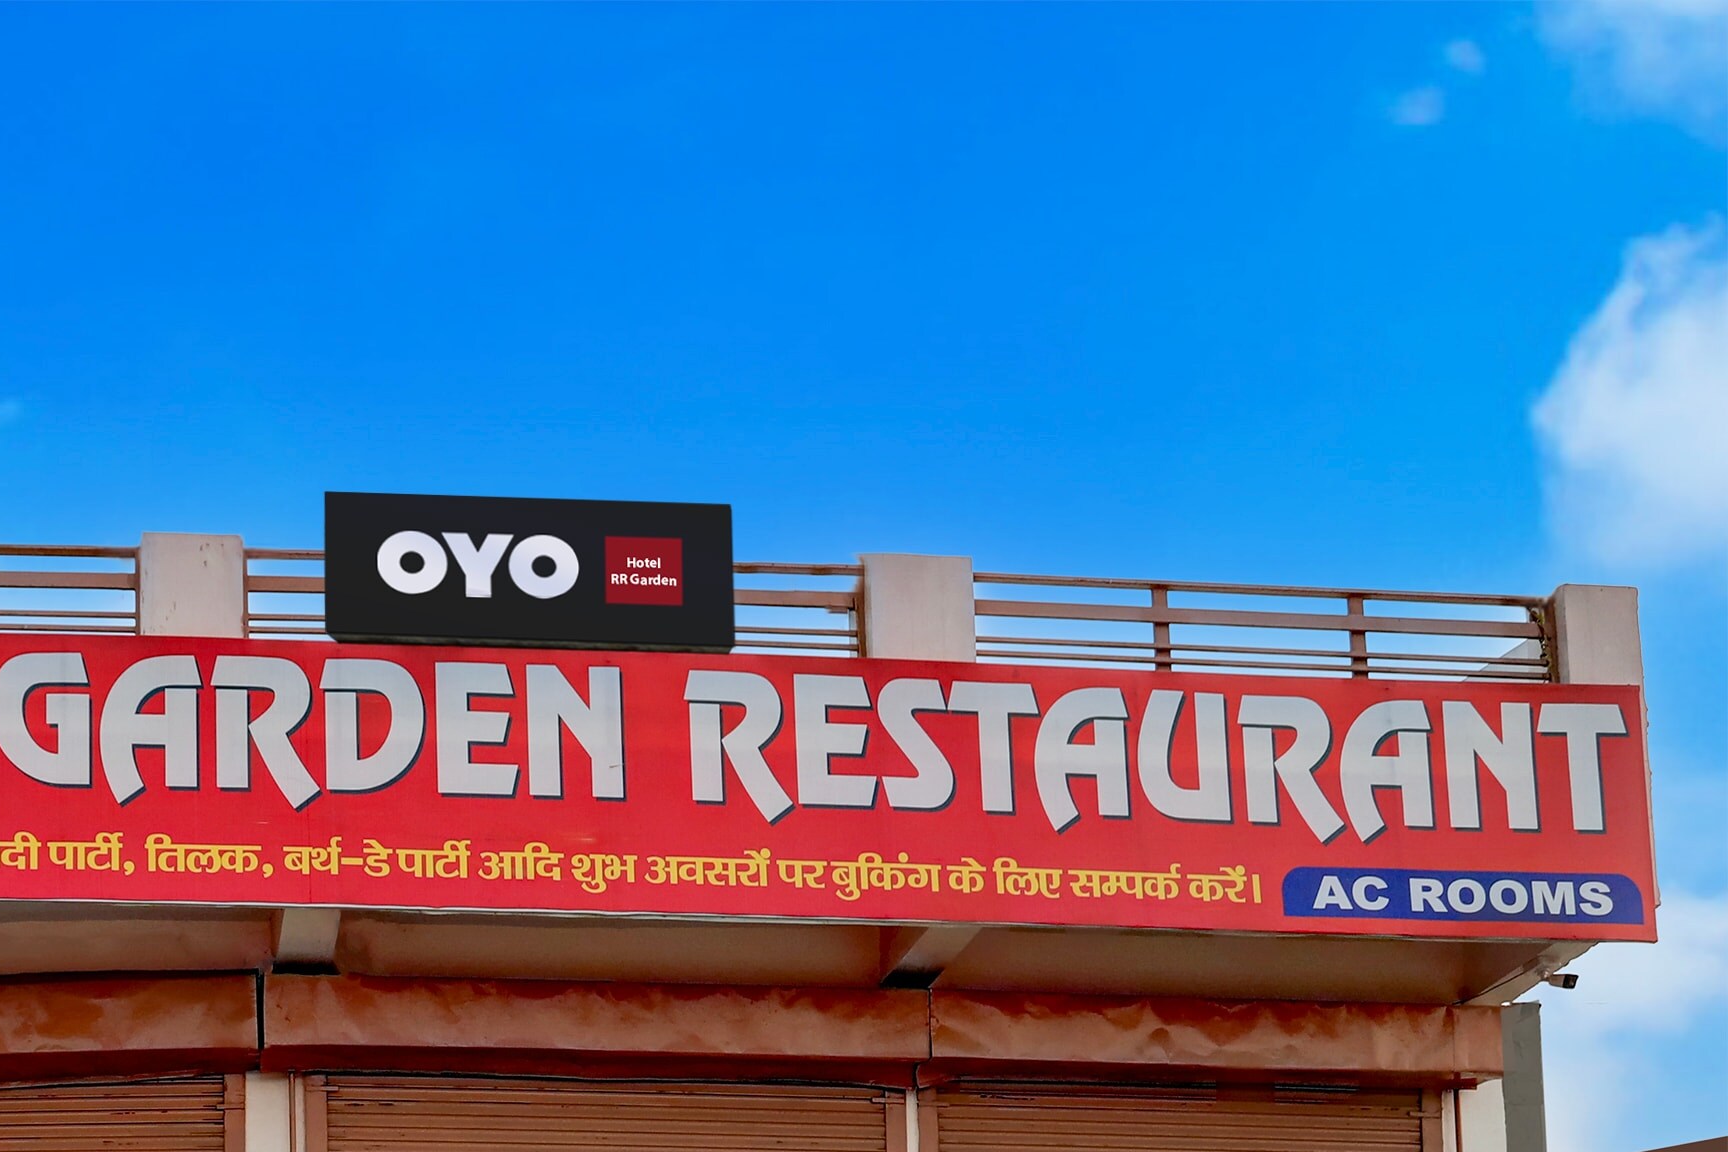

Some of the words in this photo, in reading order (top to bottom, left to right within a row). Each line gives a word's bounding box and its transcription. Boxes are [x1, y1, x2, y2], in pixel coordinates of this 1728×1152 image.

[376, 530, 580, 600] OYO
[610, 573, 628, 585] RR
[629, 574, 677, 587] Garden
[626, 556, 661, 569] Hotel
[683, 670, 1629, 845] RESTAURANT
[47, 832, 135, 875] पार्टी,
[145, 833, 274, 877] तिलक,
[395, 839, 471, 878] पार्टी
[479, 842, 564, 881] आदि
[571, 853, 637, 893] शुभ
[645, 847, 771, 888] अवसरों
[776, 859, 827, 889] पर
[831, 852, 942, 901] बुकिंग
[948, 857, 986, 893] के
[993, 857, 1063, 898] लिए
[1069, 863, 1181, 900] सम्पर्क
[1313, 876, 1390, 911] AC
[1409, 878, 1615, 916] ROOMS
